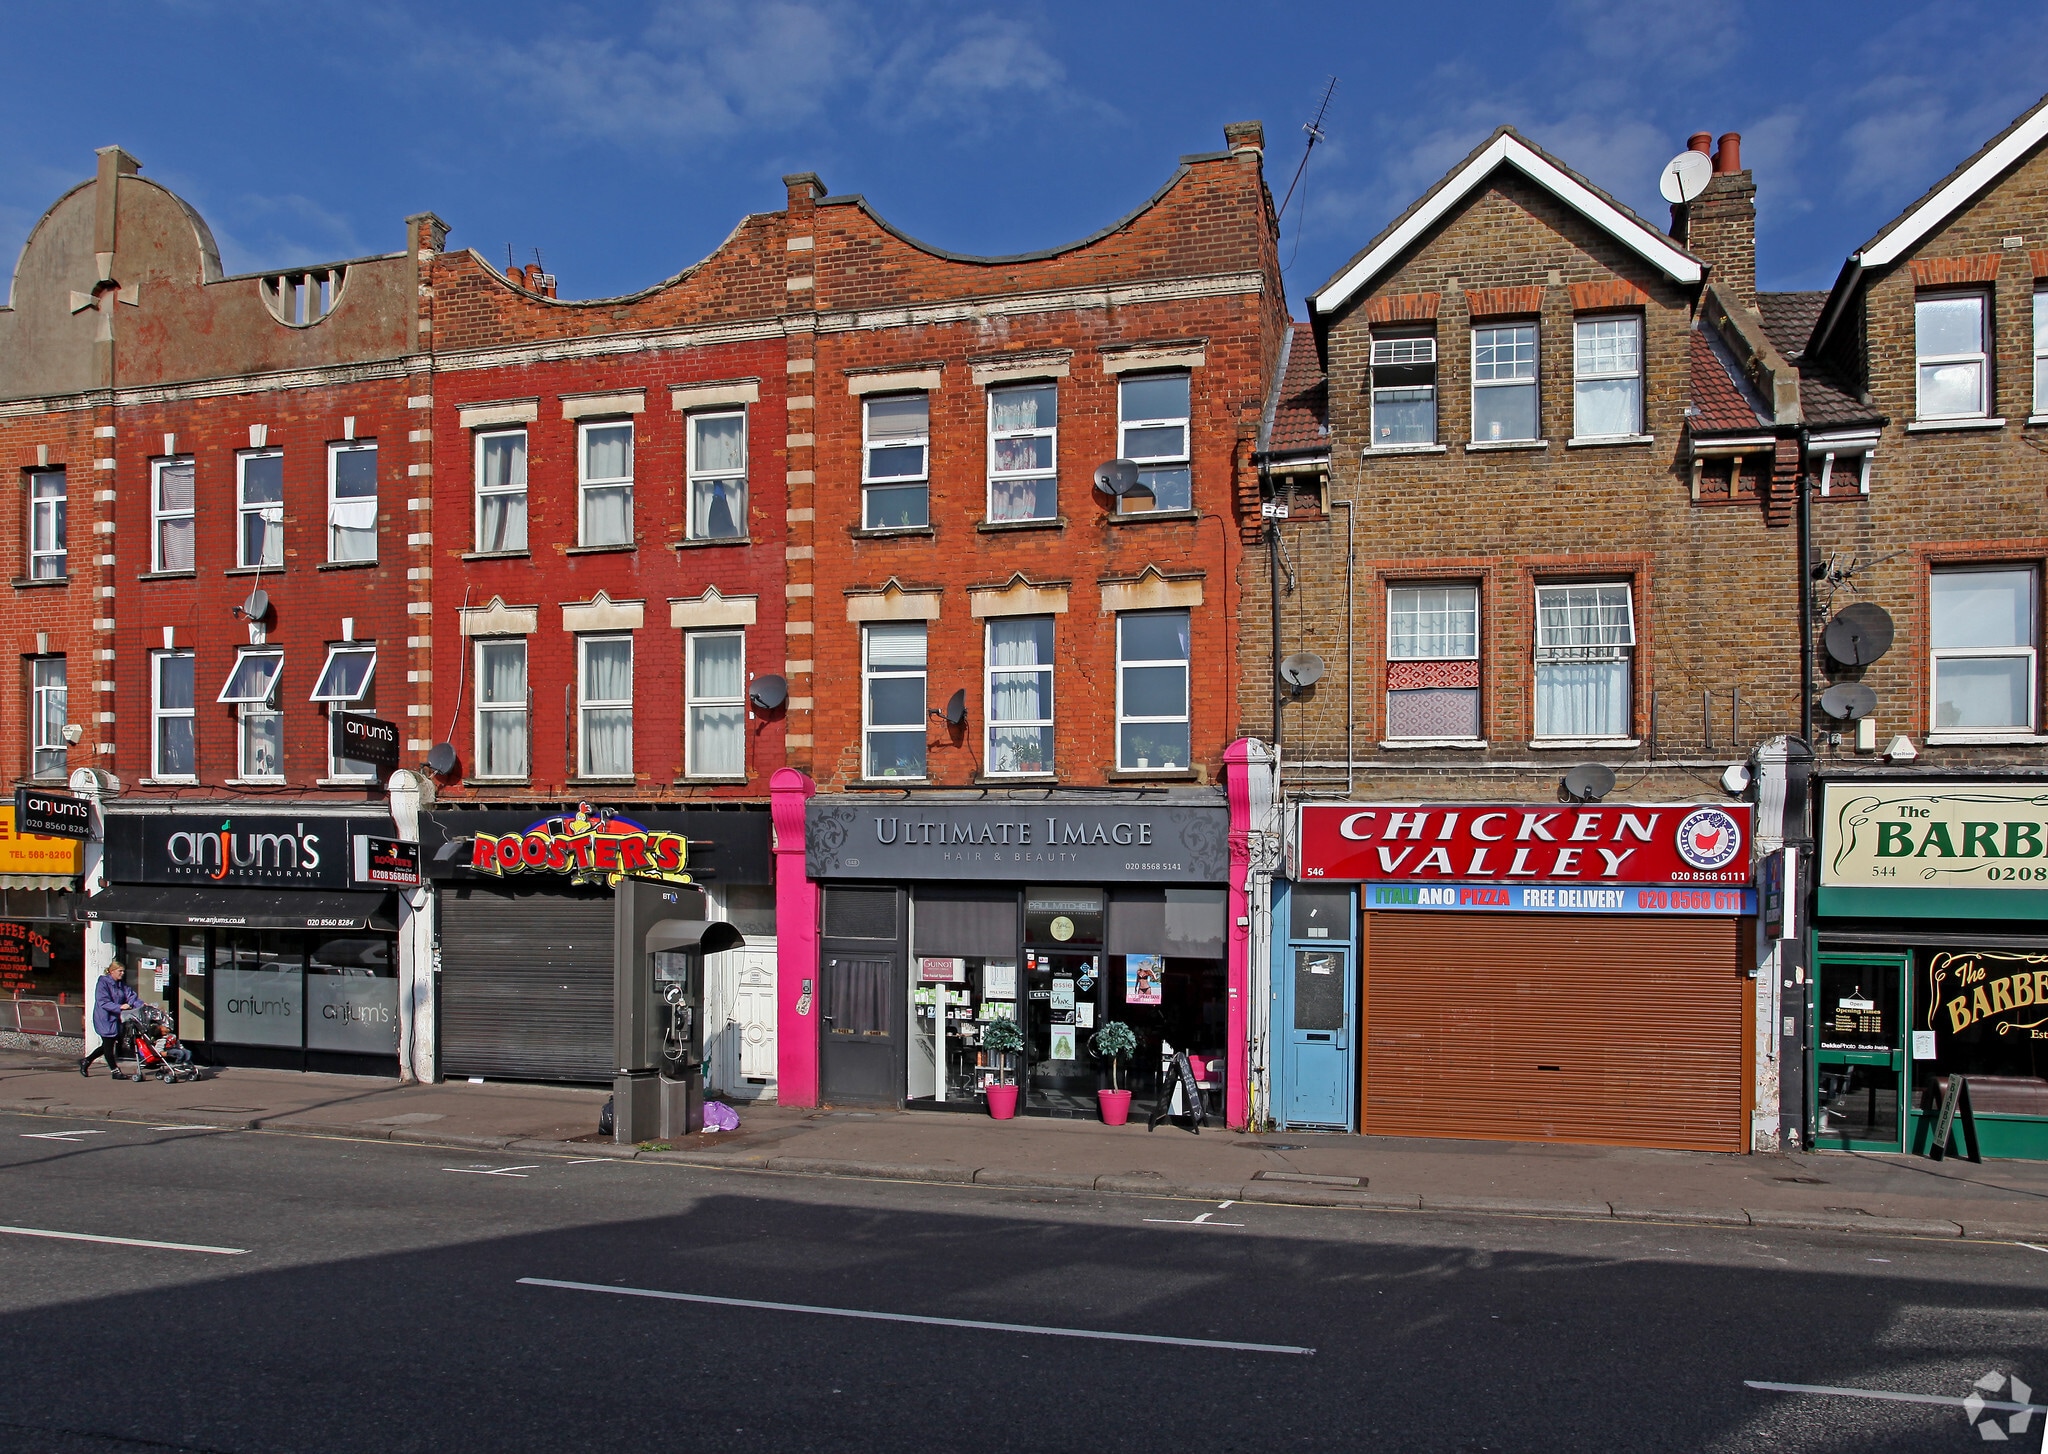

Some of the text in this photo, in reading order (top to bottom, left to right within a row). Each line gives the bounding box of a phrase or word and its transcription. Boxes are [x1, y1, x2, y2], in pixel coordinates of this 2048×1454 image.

[347, 721, 393, 741] anjum's
[28, 799, 87, 817] anjum's
[1898, 806, 1930, 818] The
[26, 819, 89, 834] 020 8560 8284
[874, 817, 1152, 846] ULTIMATE IMAGE
[1340, 812, 1662, 841] CHICKEN
[1682, 814, 1704, 858] CHICKEN
[1713, 828, 1736, 863] VALLEY
[1874, 821, 2048, 858] BARB
[167, 820, 320, 879] anjum's
[472, 834, 681, 870] ROOSTER'S
[944, 852, 1077, 861] HAIR & BEAUTY
[1376, 846, 1639, 876] VALLEY
[230, 869, 322, 878] RESTAURANT
[372, 870, 389, 880] 0208
[1307, 868, 1324, 876] 546
[1671, 872, 1745, 881] 020 8568 6111
[1872, 866, 1896, 877] 544
[1987, 867, 2047, 881] 0208
[1375, 888, 1746, 910] ITALIANO PIZZA FREE DELIVERY 020 8568 6111
[188, 916, 246, 925] www.anjums.co.uk
[923, 959, 952, 968] GUINOT
[1955, 960, 1986, 987] The
[227, 995, 291, 1016] anjum's
[322, 1001, 389, 1025] anjum's
[1836, 1007, 1861, 1015] Opening
